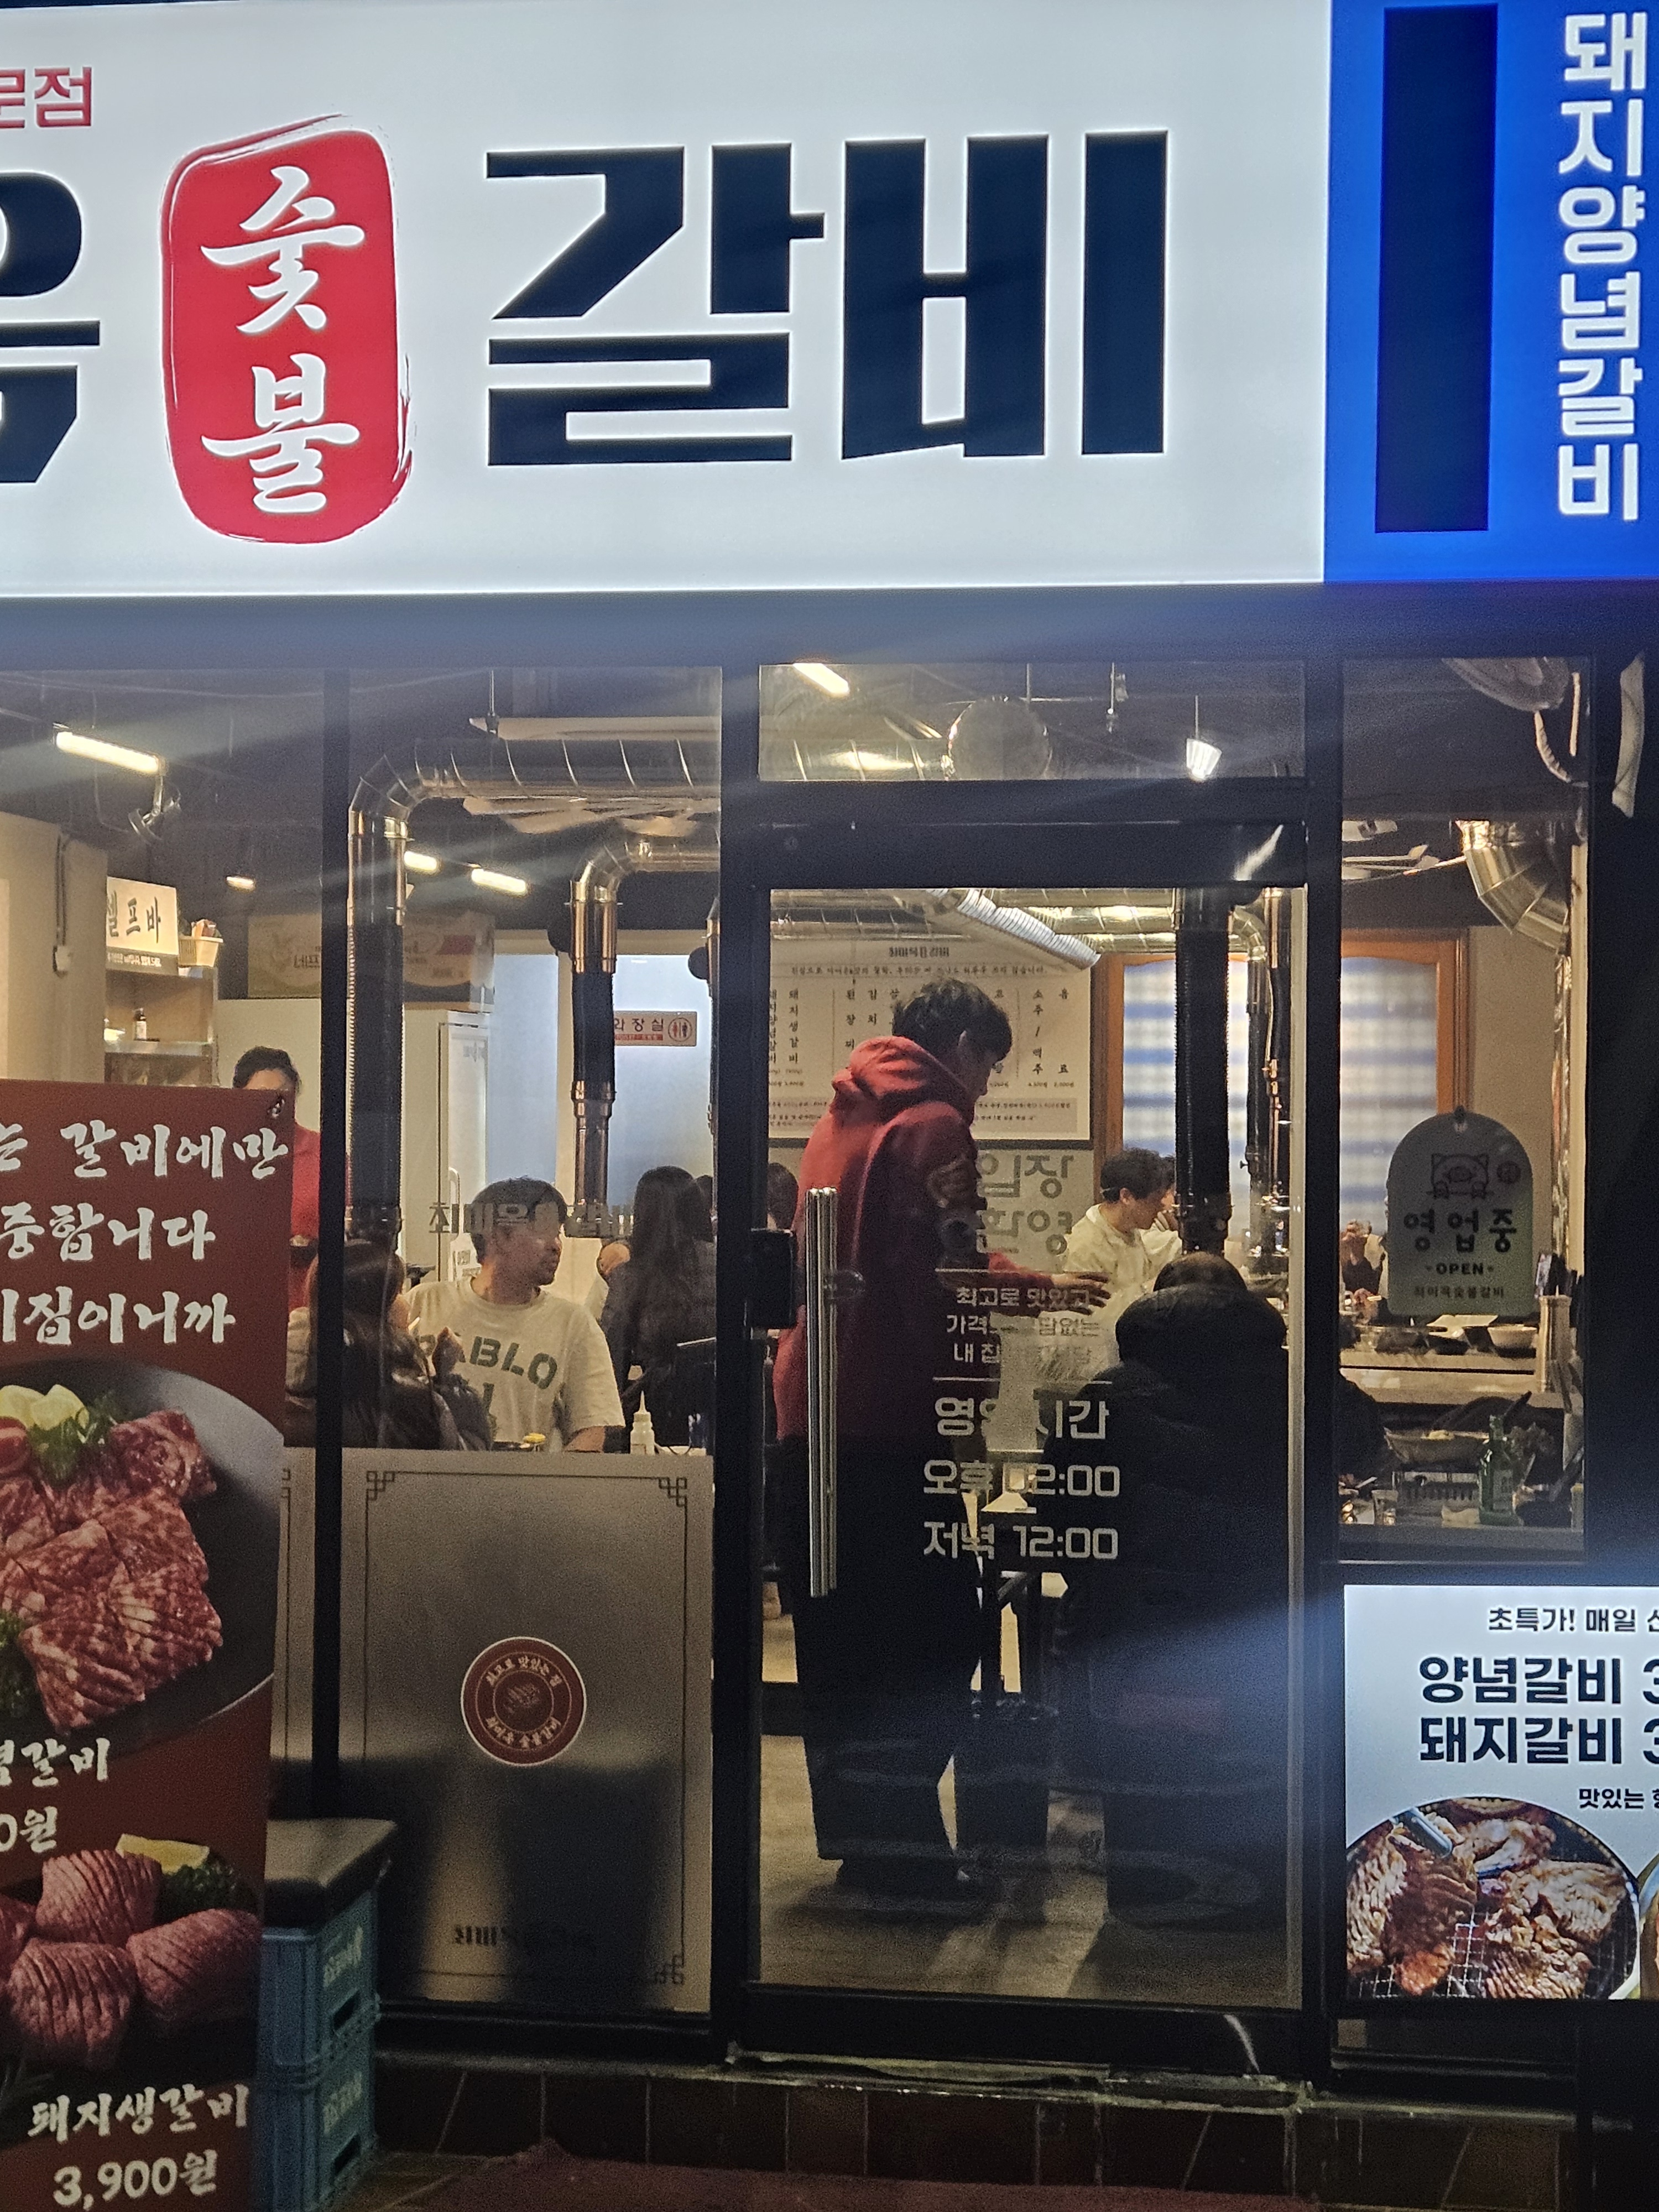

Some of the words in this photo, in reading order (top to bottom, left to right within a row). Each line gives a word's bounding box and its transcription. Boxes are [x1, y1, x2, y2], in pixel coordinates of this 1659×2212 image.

[1558, 11, 1648, 521] 돼지양념갈비
[487, 131, 1168, 466] 갈비
[200, 165, 366, 514] 숯불
[60, 1119, 288, 1180] 갈비에만
[1404, 1209, 1517, 1253] 영업중
[1436, 1262, 1484, 1275] OPEN
[956, 1286, 1020, 1307] 최고로
[953, 1343, 974, 1363] 내
[924, 1459, 994, 1496] 오후
[924, 1521, 995, 1560] 저녁
[1013, 1525, 1119, 1559] 12:00
[1488, 1607, 1575, 1632] 초특가!
[1586, 1608, 1636, 1632] 매일
[1420, 1657, 1621, 1704] 양념갈비
[1420, 1717, 1622, 1764] 돼지갈비
[1579, 1788, 1645, 1810] 맛있는
[27, 2083, 250, 2142] 돼지생갈비
[54, 2150, 218, 2211] 3,900원
